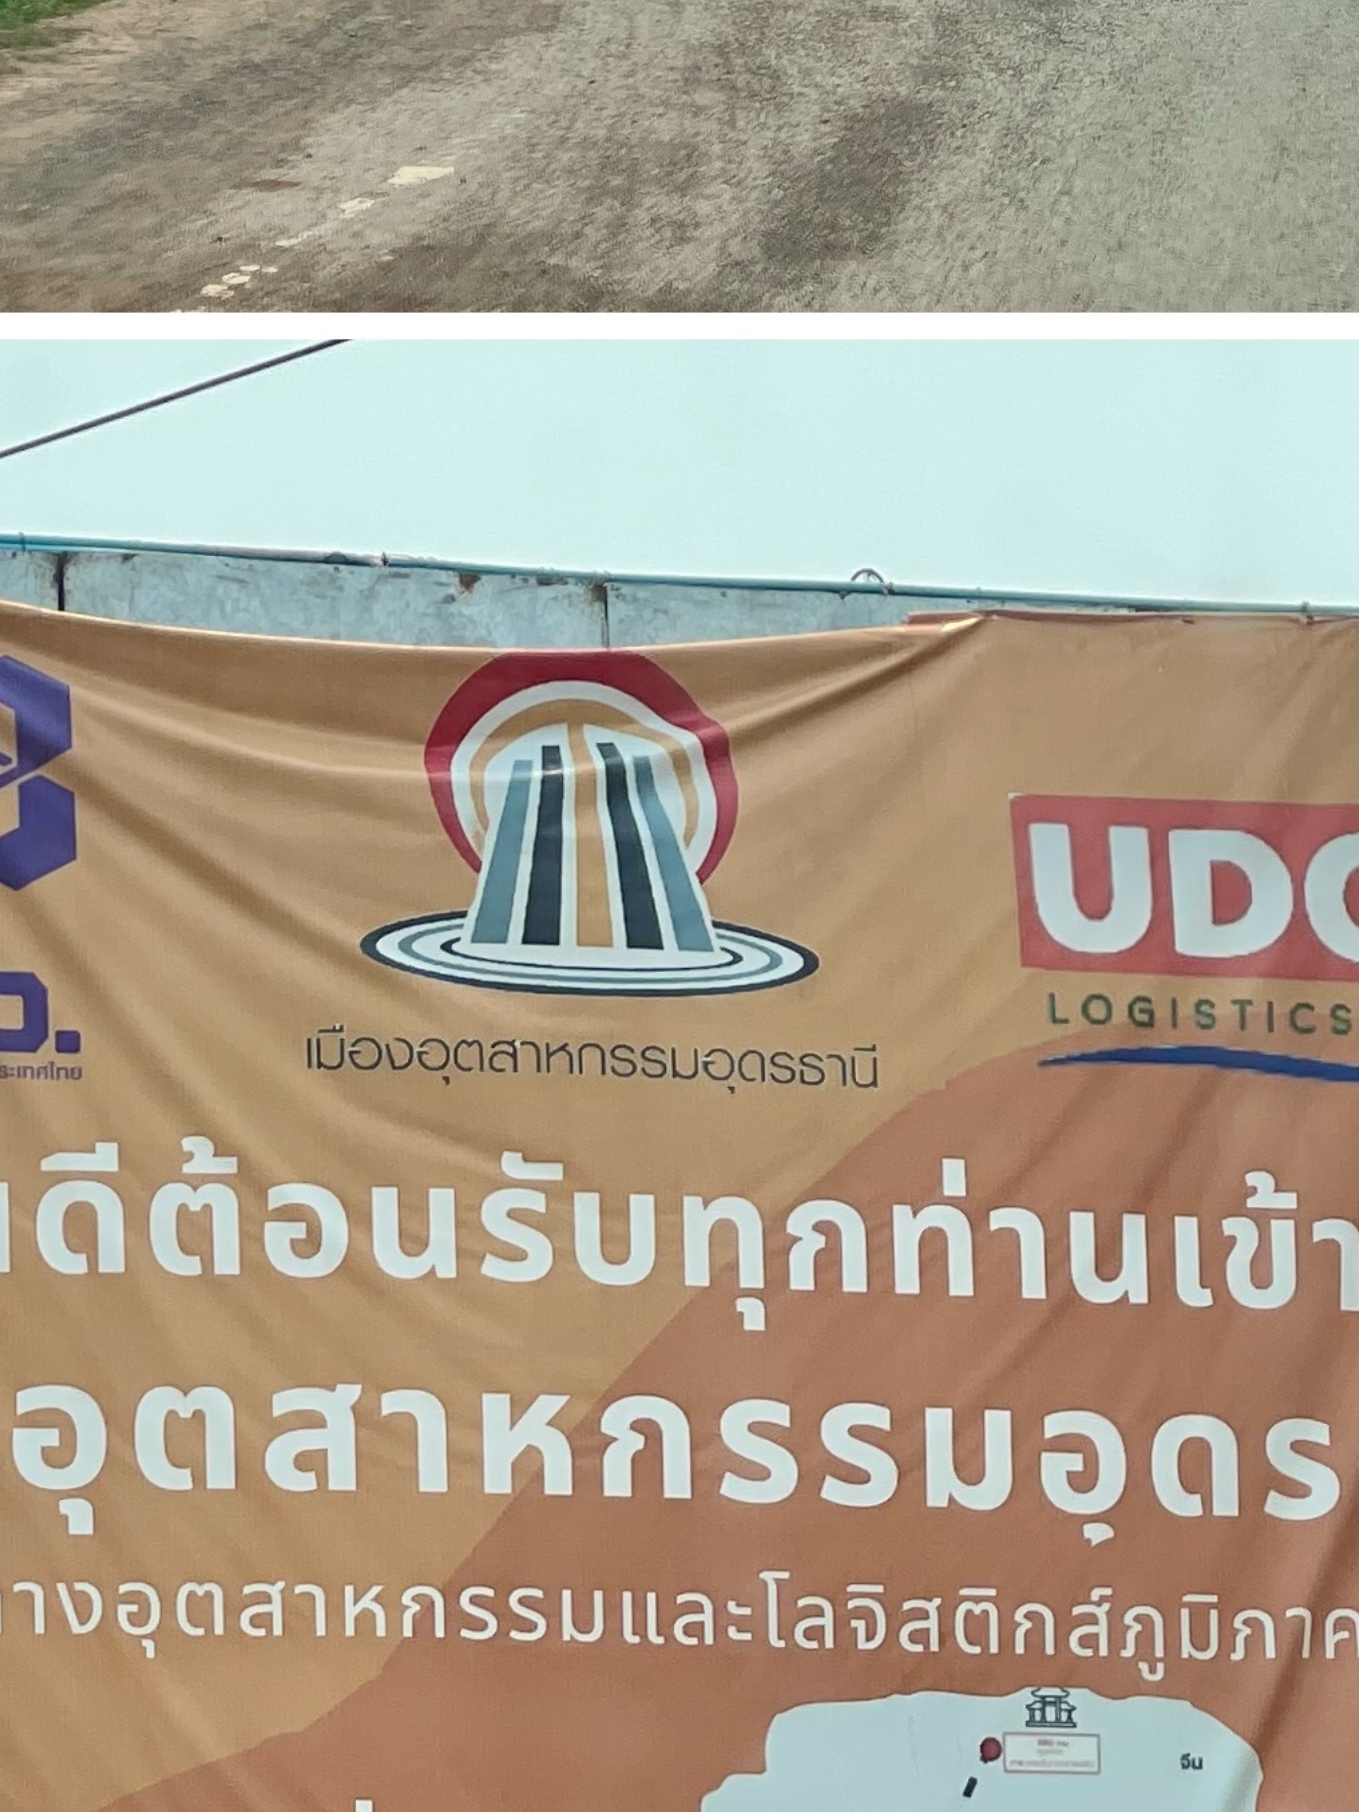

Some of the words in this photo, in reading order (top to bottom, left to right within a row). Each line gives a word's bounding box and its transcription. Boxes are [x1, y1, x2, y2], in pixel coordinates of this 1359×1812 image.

[1047, 991, 1353, 1035] LOGISTICS
[306, 1023, 881, 1094] เมืองอุตสาหกรรมอุดรธานี
